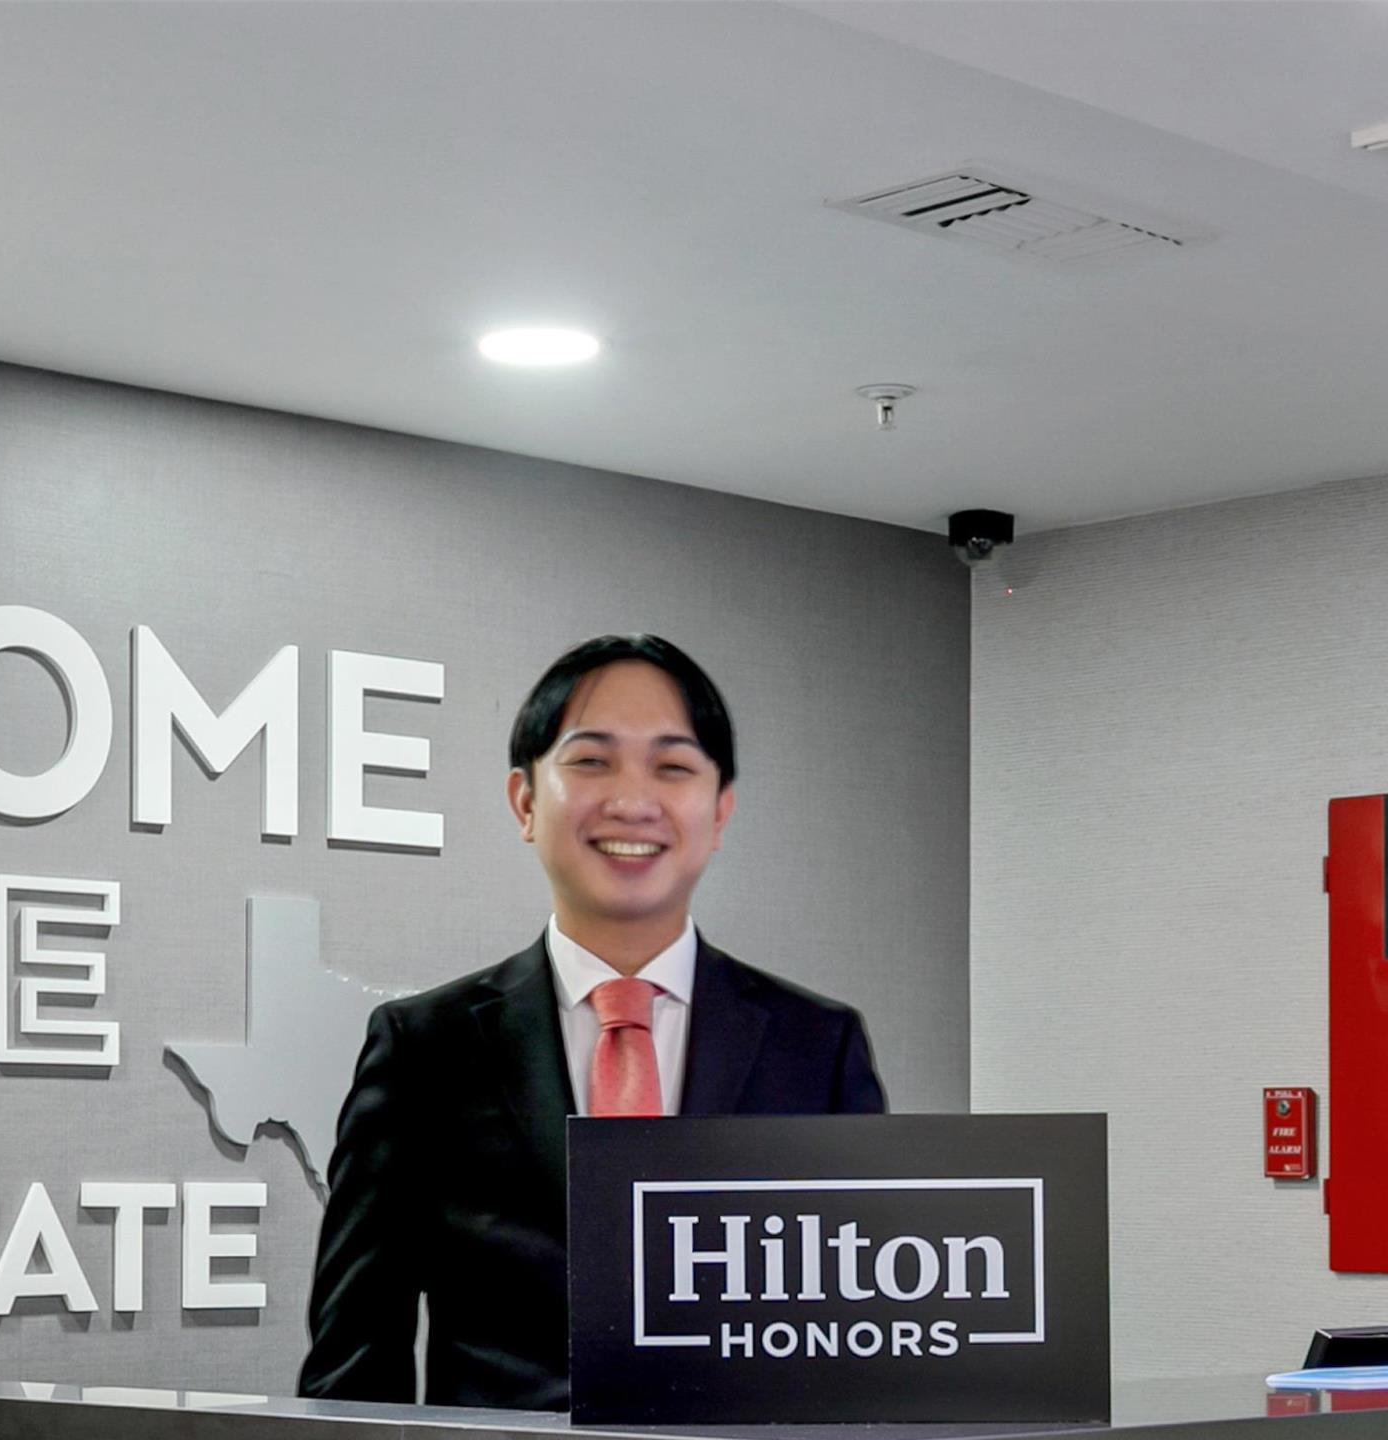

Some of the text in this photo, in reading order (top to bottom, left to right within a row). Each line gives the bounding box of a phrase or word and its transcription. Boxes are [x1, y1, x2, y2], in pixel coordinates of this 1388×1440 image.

[1273, 1127, 1297, 1136] FIRE
[1269, 1145, 1301, 1154] ALARM
[668, 1214, 1010, 1302] Hilton
[720, 1320, 959, 1359] HONORS
